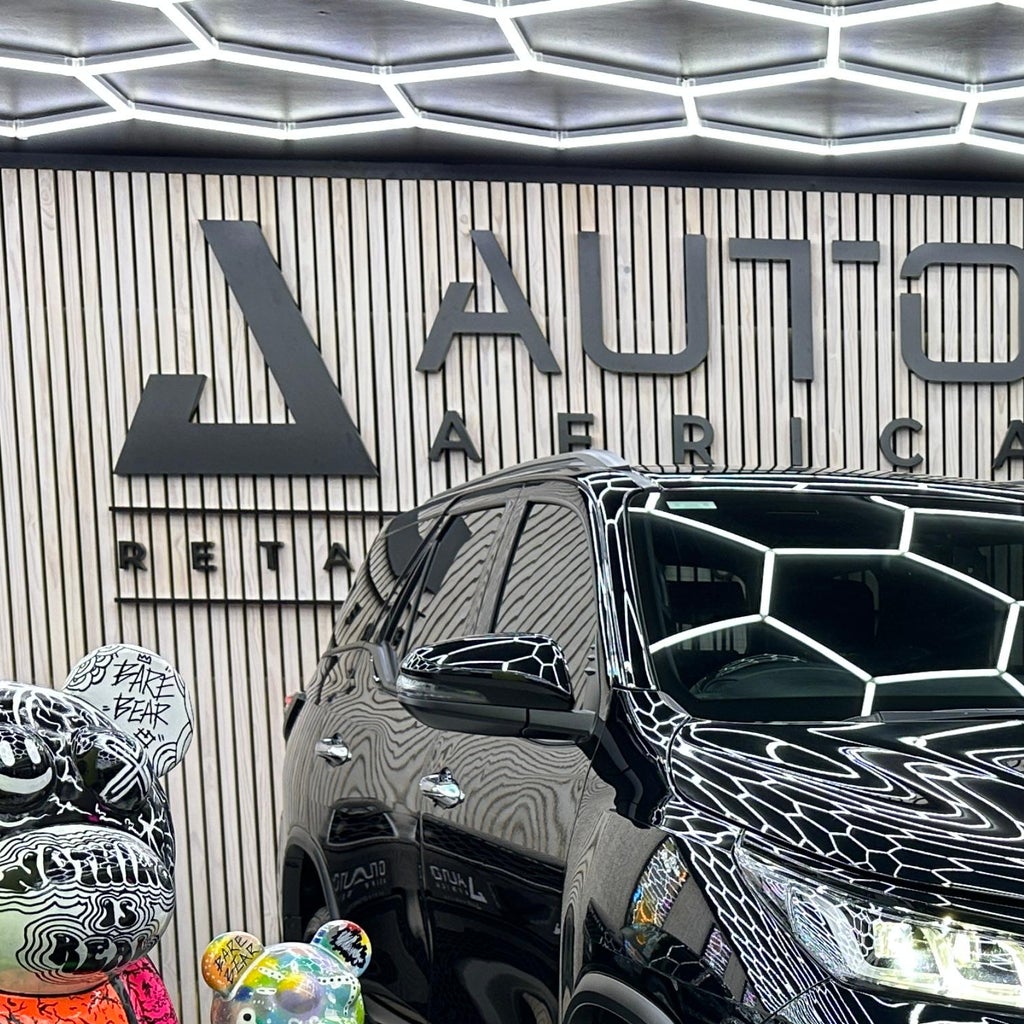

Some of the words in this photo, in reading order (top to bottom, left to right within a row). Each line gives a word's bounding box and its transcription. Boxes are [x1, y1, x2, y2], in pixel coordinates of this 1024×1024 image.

[118, 540, 355, 573] RETA
[111, 659, 175, 701] BARE
[113, 692, 171, 729] BEAR
[213, 935, 248, 973] BARE
